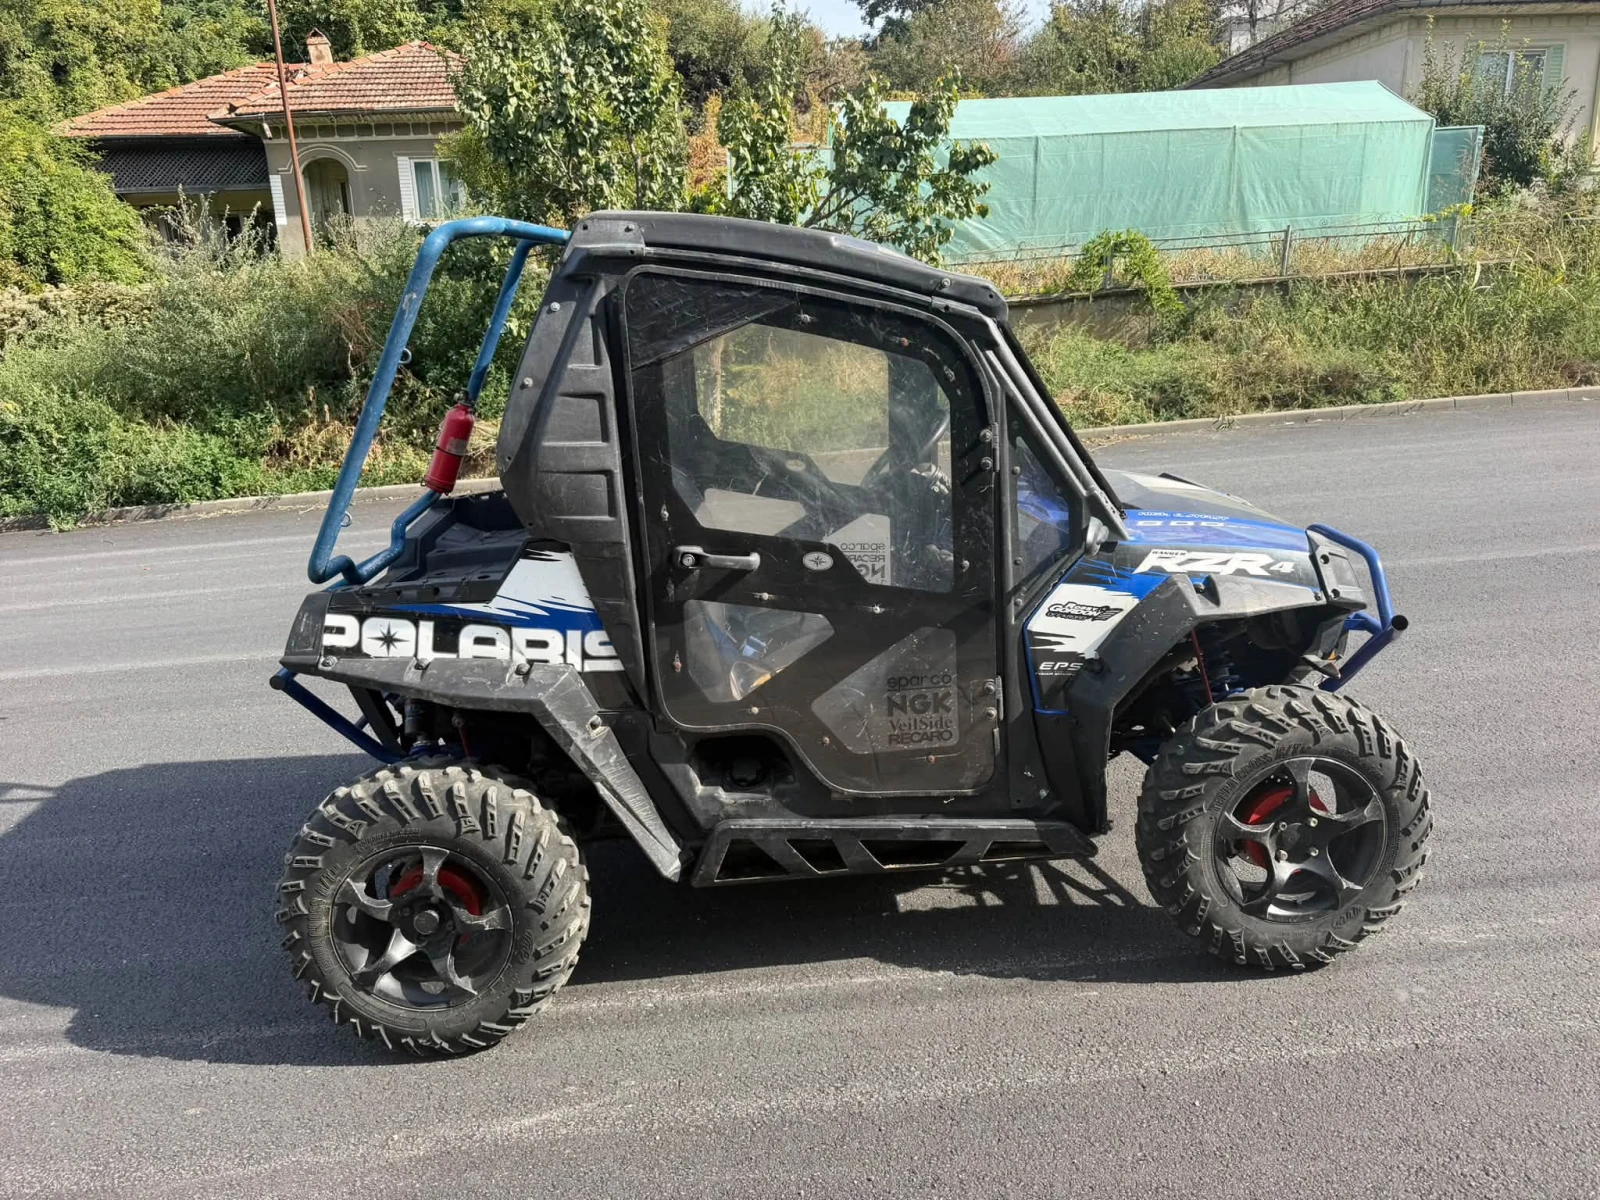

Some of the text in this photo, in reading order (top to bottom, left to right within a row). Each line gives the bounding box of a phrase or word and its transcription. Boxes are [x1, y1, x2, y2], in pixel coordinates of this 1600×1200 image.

[1132, 550, 1295, 576] RZR 4
[1049, 605, 1101, 617] GORDON
[322, 614, 626, 672] POLARIS
[1039, 661, 1084, 671] EPS
[887, 674, 952, 692] sparco
[887, 691, 952, 717] NGK
[889, 717, 953, 732] VeilSide
[888, 730, 953, 746] RECARO
